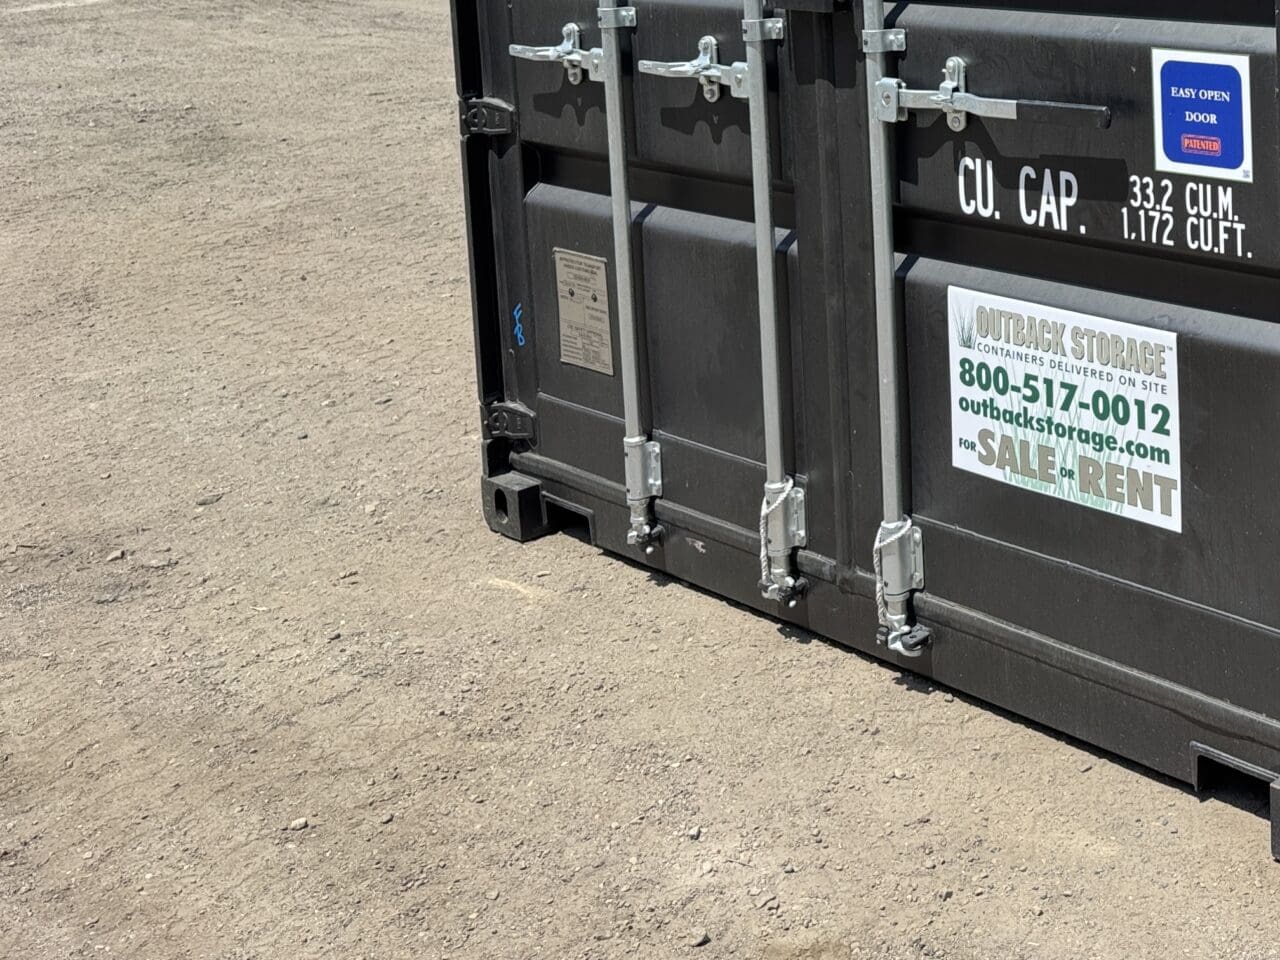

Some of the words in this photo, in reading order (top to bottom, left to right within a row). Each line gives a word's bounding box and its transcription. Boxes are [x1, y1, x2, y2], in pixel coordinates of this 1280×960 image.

[1171, 86, 1198, 99] EASY
[1199, 89, 1230, 102] OPEN
[1185, 111, 1218, 124] DOOR
[1184, 138, 1219, 151] PATENTED
[958, 156, 1000, 220] CU.
[1129, 175, 1173, 212] 33.2
[1186, 182, 1239, 221] CU.M.
[1121, 207, 1174, 246] 1,172
[1186, 217, 1252, 258] CU.FT.
[976, 305, 1067, 357] OUTBACK
[1070, 325, 1167, 379] STORAGE
[977, 343, 1045, 367] CONTAINERS
[1050, 359, 1113, 382] DELIVERED
[1119, 375, 1136, 388] ON
[1141, 380, 1168, 395] SITE
[959, 357, 1171, 437] 800-517-0012
[959, 397, 1171, 465] outbackstorage.com
[959, 437, 977, 452] FOR
[977, 428, 1057, 485] SALE
[1060, 466, 1075, 480] OR
[1078, 454, 1178, 517] RENT
